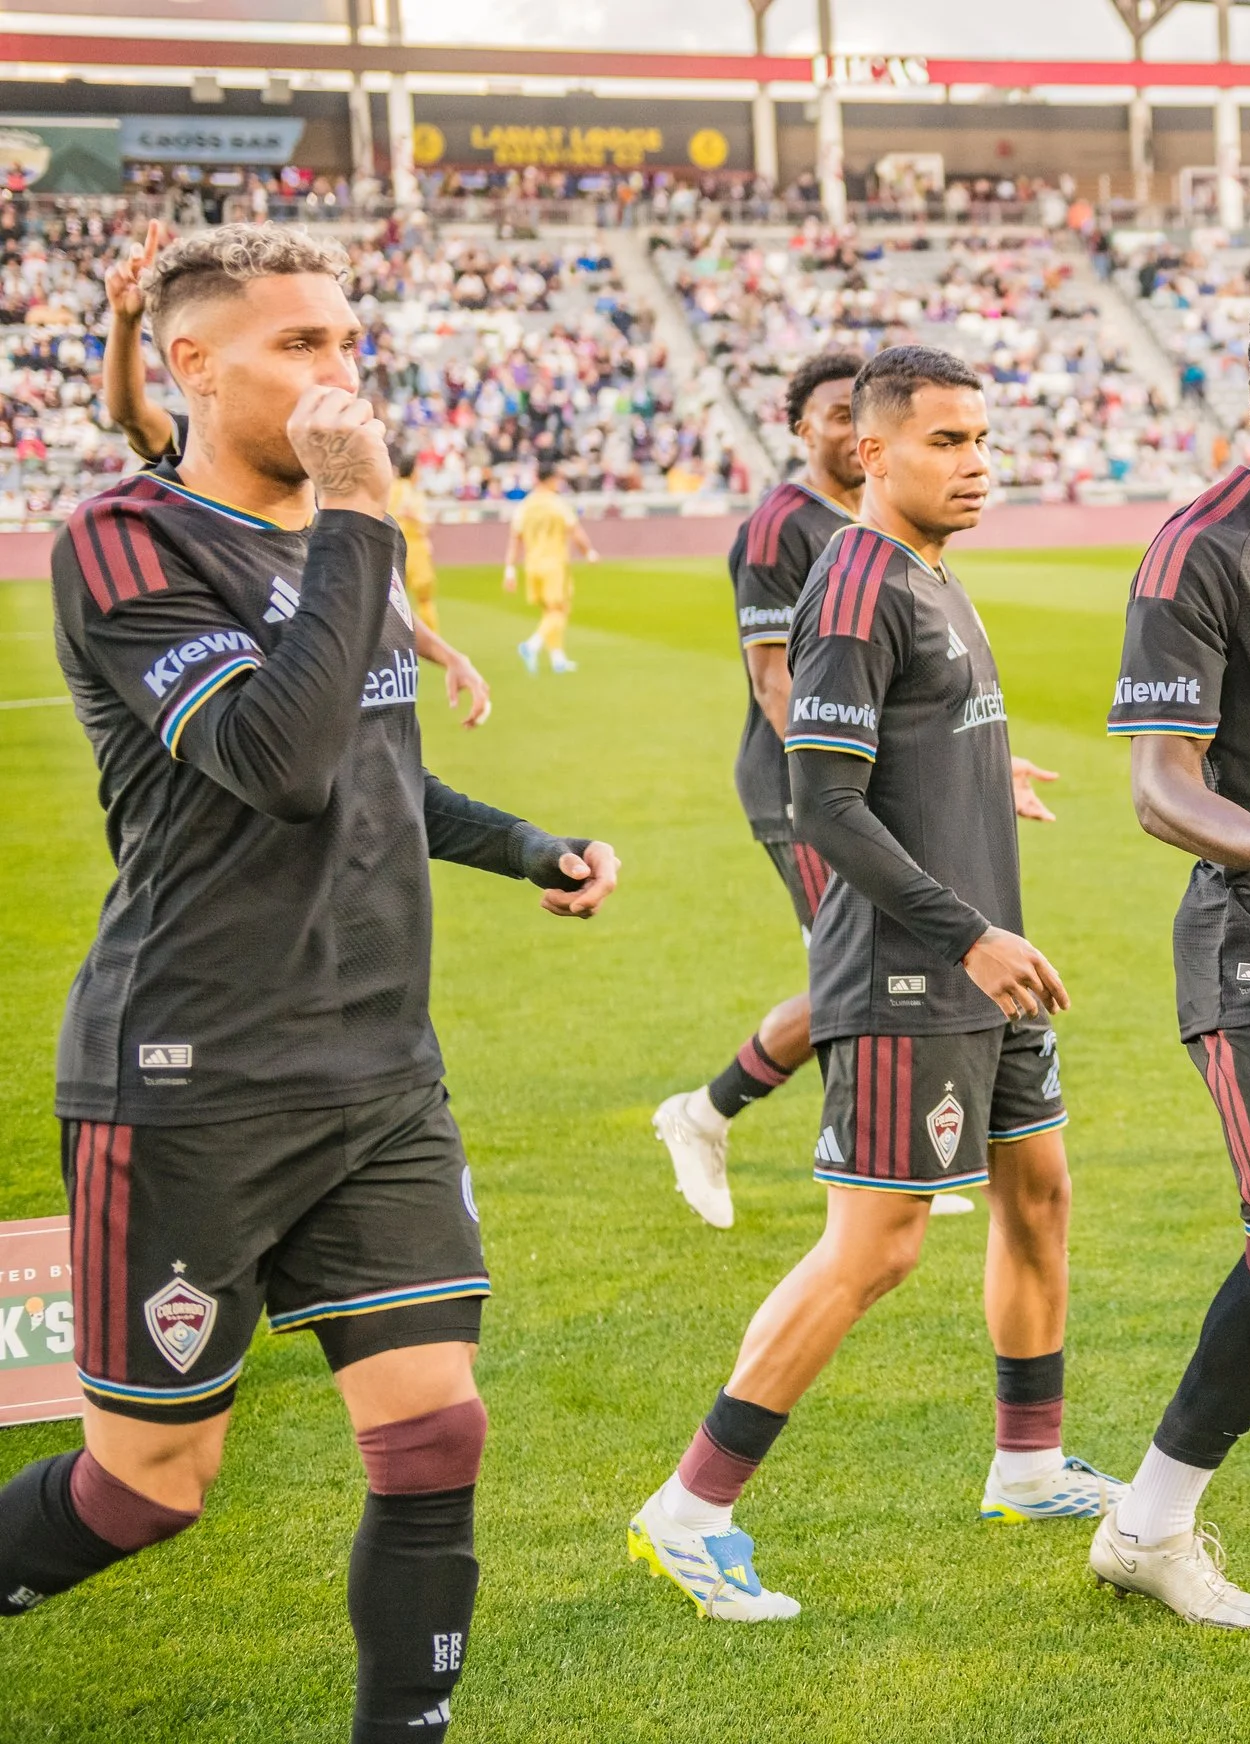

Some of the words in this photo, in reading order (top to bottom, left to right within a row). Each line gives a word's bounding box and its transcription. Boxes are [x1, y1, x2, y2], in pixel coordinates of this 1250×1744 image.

[143, 631, 262, 698] Kiewi
[1112, 676, 1201, 706] Kiewit
[793, 696, 876, 731] Kiewit
